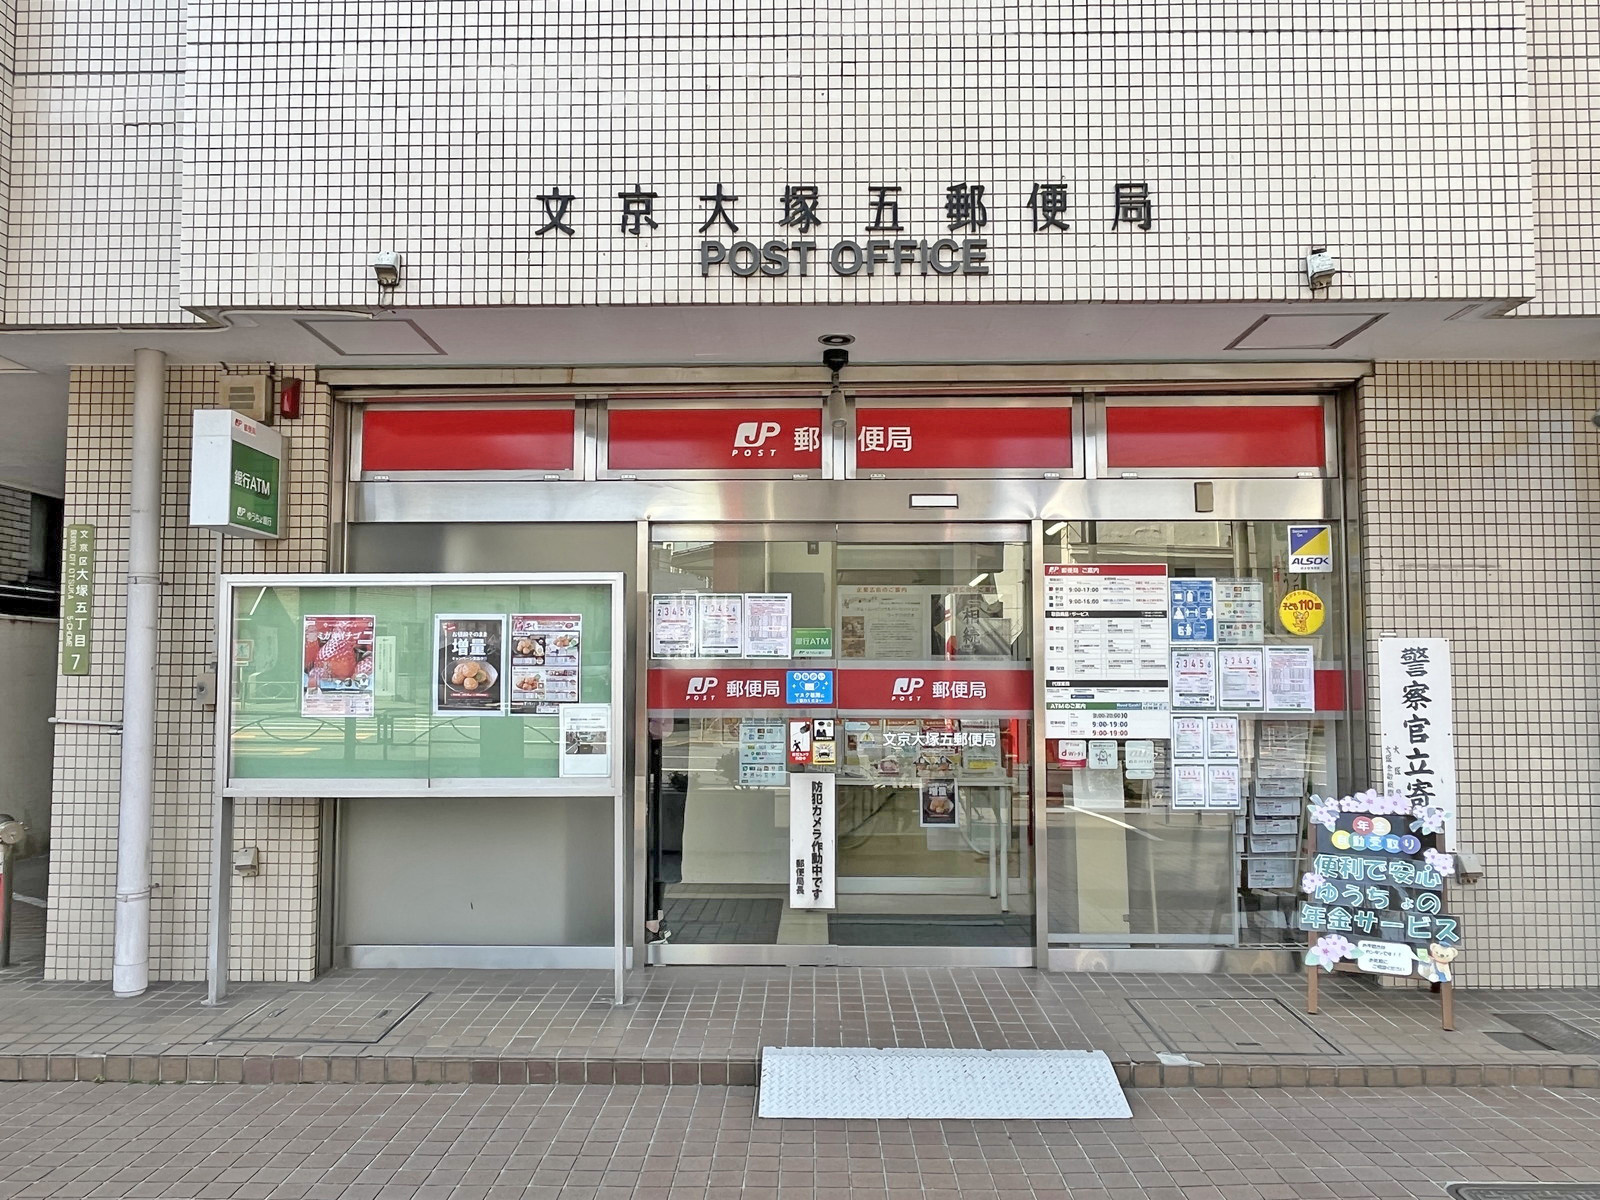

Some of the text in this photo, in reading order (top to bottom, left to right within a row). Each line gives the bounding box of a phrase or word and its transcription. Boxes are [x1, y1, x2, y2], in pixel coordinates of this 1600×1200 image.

[535, 182, 1152, 236] 文京大塚五郵便局
[701, 238, 990, 277] POST OFFICE
[731, 449, 777, 457] POST
[234, 469, 271, 496] 銀行ATM
[1291, 557, 1329, 565] ALSOK
[67, 568, 76, 600] OTSUKA
[73, 529, 89, 648] 文京区大塚五丁目
[71, 653, 81, 670] 7
[451, 638, 487, 656] 増量
[726, 680, 780, 698] 郵便局
[932, 681, 987, 699] 郵便局
[882, 732, 996, 747] 文京大塚五郵便局
[1400, 646, 1437, 808] 警察官立寄
[811, 780, 823, 900] 防犯カメラ作動中です
[795, 859, 805, 895] 郵便局長
[1313, 853, 1442, 888] 便利で安心
[1314, 882, 1442, 915] ゆうちょの
[1301, 903, 1460, 943] 年金サービス
